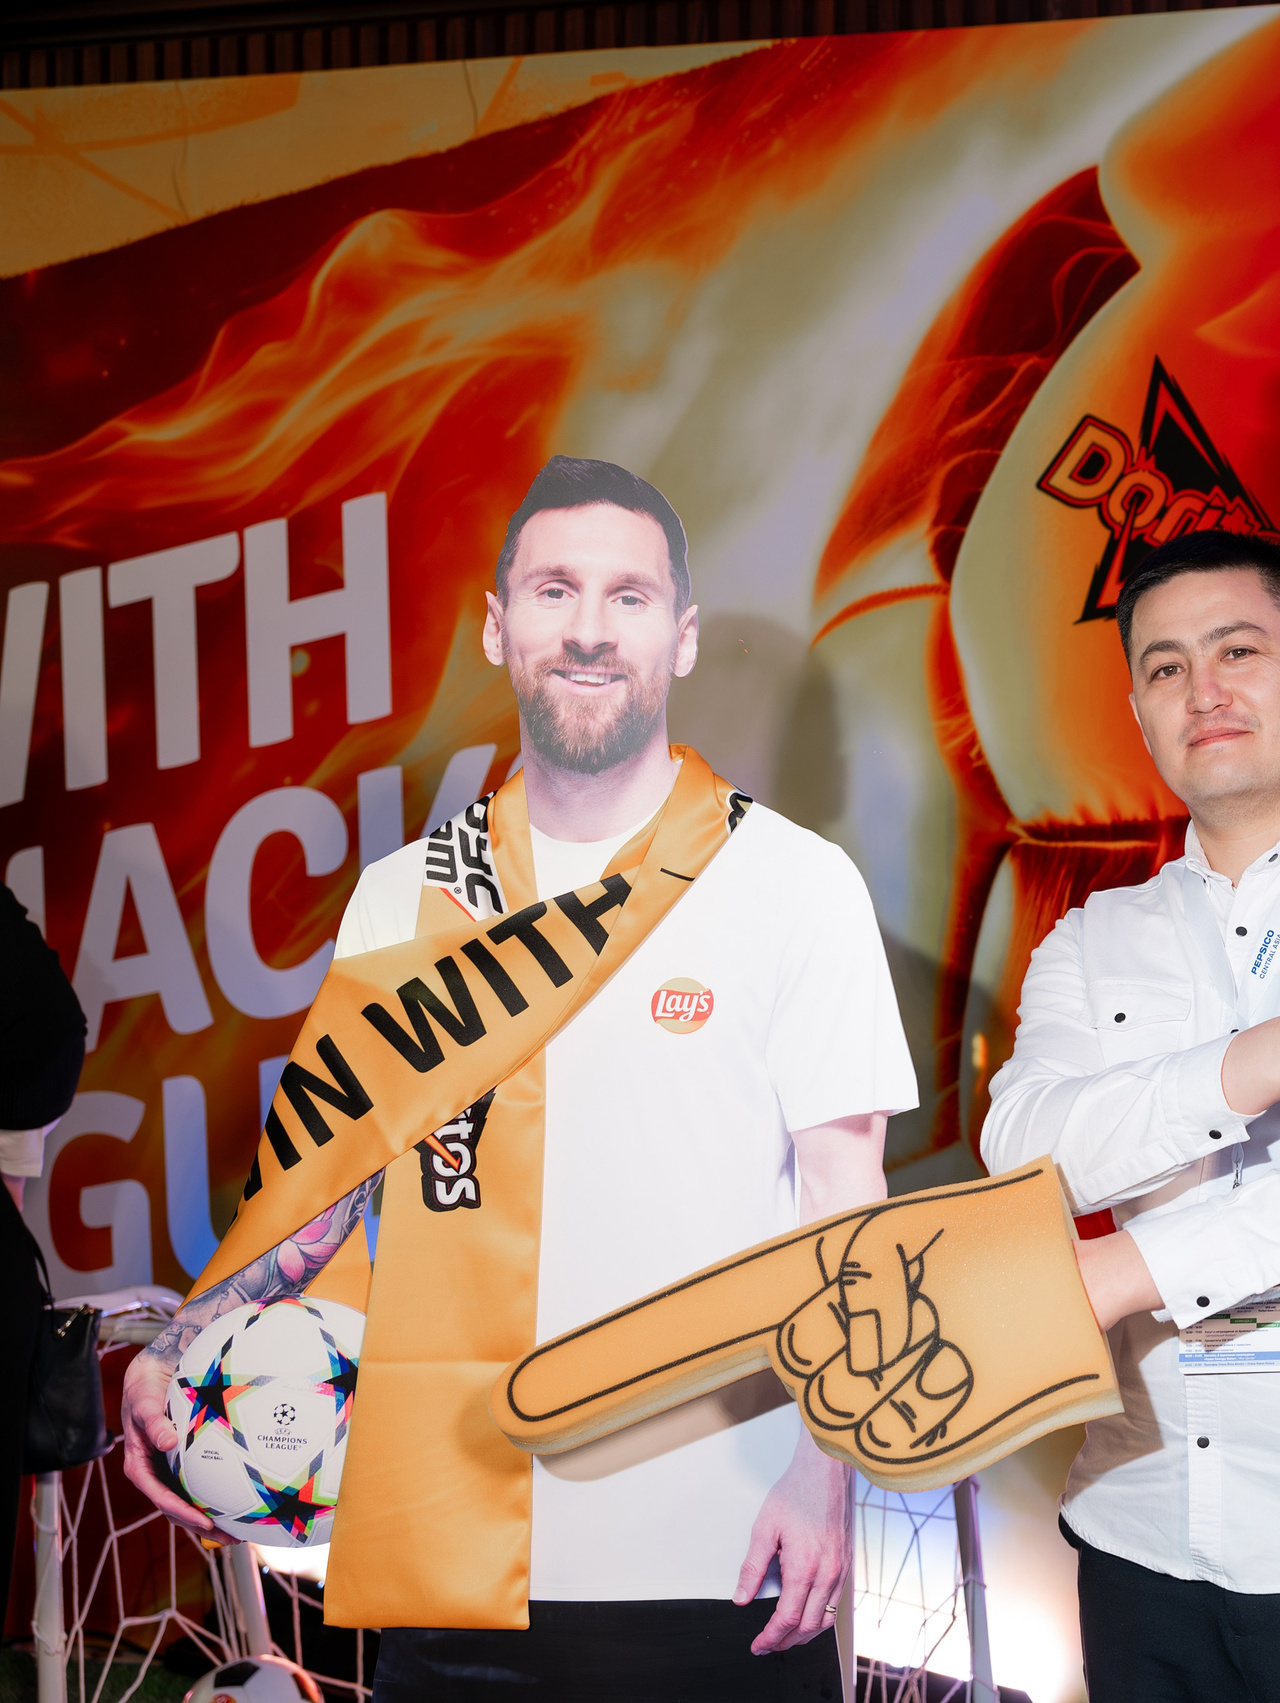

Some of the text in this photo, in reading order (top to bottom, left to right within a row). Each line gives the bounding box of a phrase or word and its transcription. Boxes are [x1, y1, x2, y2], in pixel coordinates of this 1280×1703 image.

[1250, 929, 1275, 975] PEPSICO
[1259, 950, 1277, 980] CENTRAL
[655, 990, 712, 1023] Lay's
[244, 1033, 375, 1202] IN
[257, 1434, 308, 1445] CHAMPIONS
[265, 1442, 299, 1451] LEAGUE
